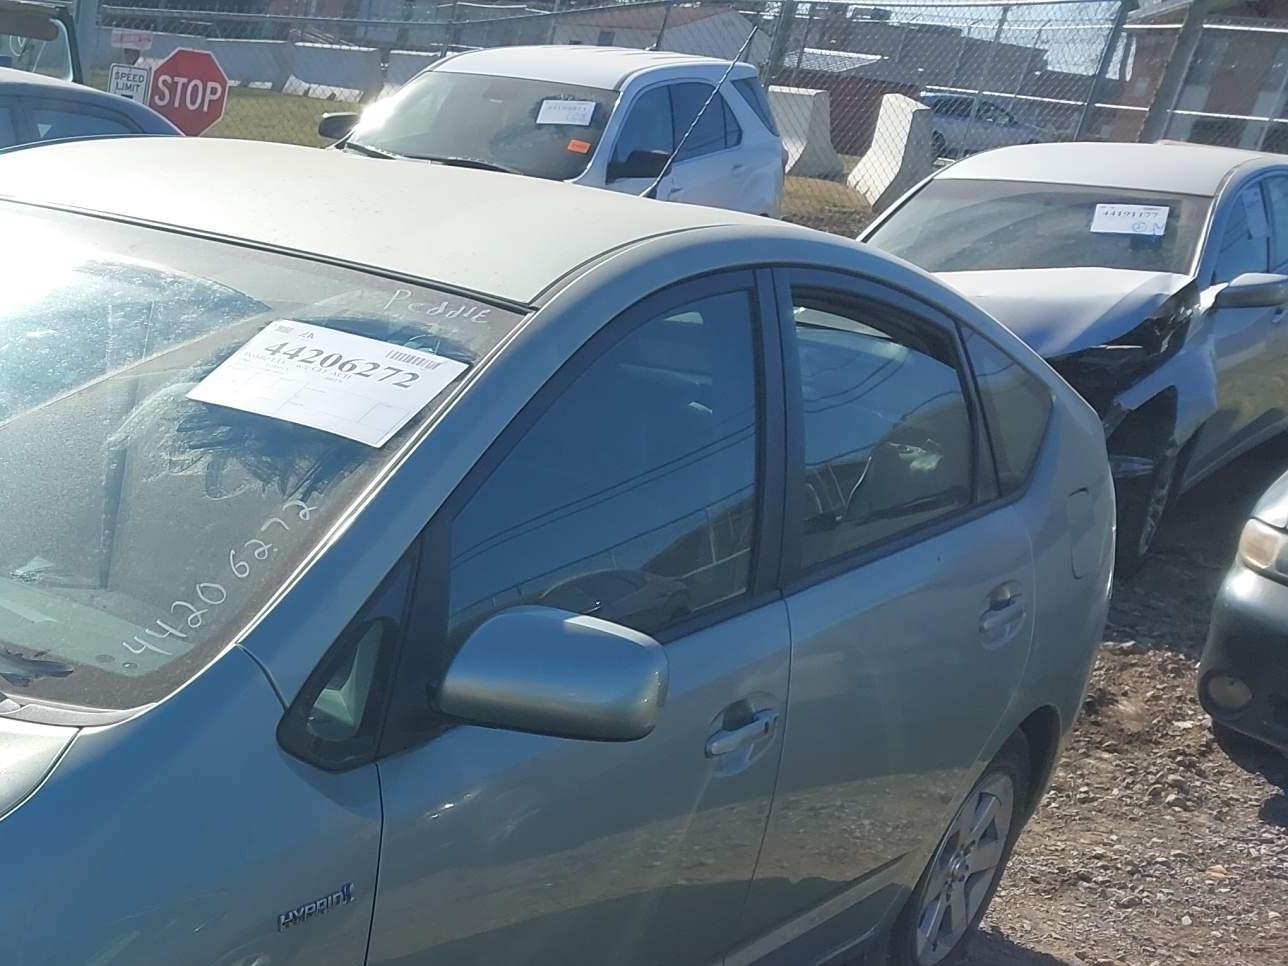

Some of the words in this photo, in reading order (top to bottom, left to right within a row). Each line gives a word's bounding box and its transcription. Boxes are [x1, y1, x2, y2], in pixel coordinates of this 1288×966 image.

[114, 72, 145, 83] SPEED
[116, 83, 140, 93] LIMIT
[155, 75, 223, 113] STOP
[265, 342, 421, 389] 44206272
